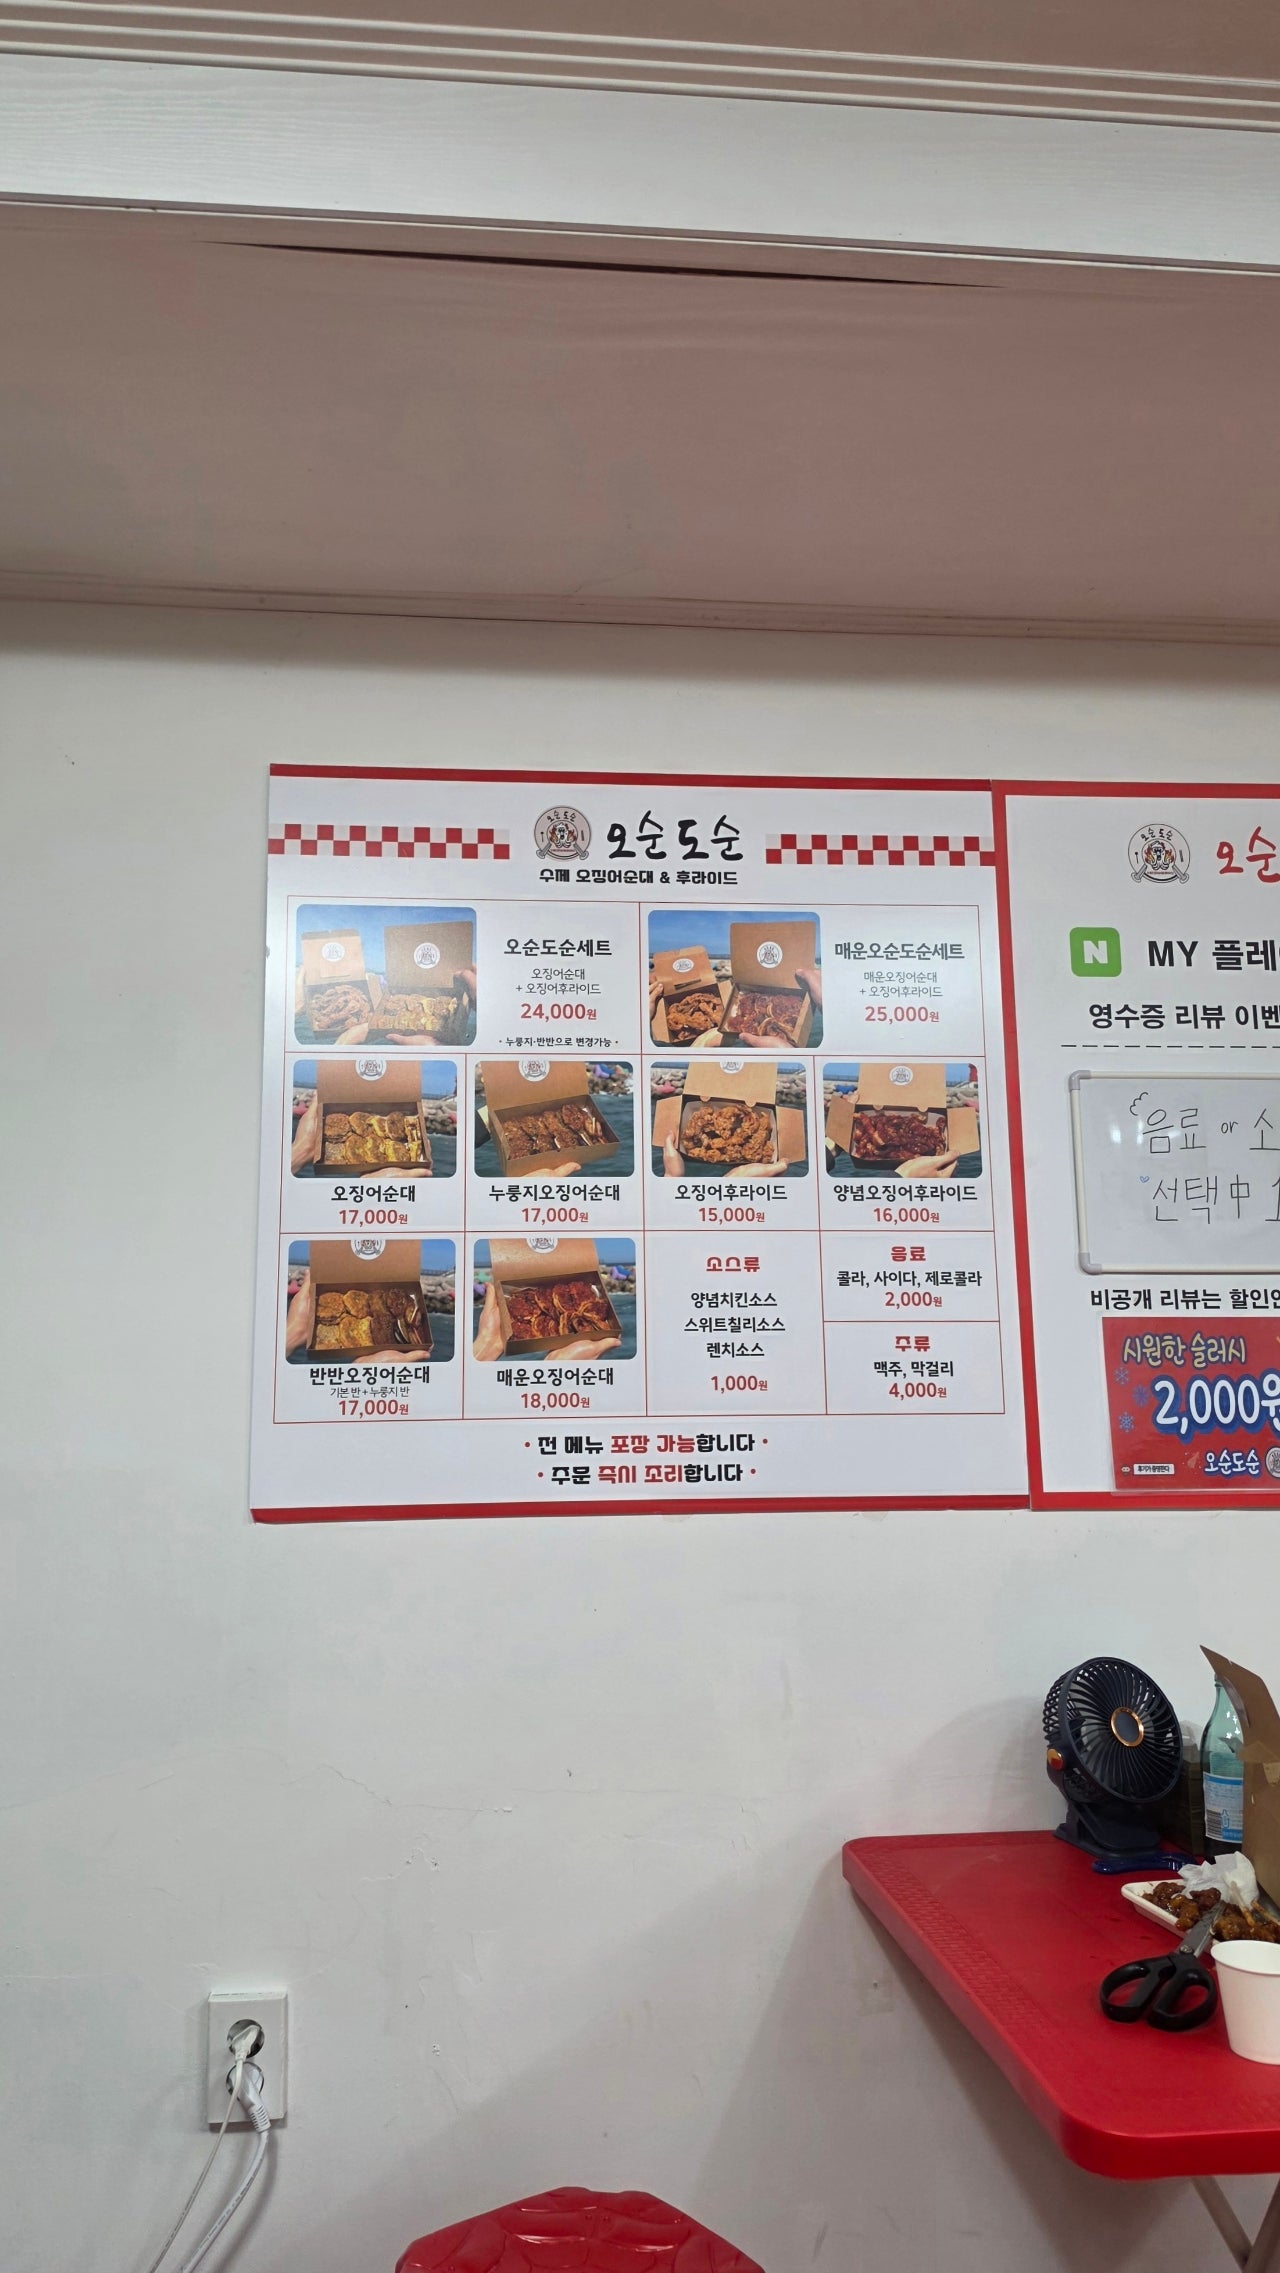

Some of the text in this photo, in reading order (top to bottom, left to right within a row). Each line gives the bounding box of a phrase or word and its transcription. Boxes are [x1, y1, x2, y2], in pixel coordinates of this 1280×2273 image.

[607, 810, 743, 861] 오순도순
[539, 869, 738, 885] 수제 오징어순대 & 후라이드
[504, 939, 612, 957] 오순도순세트
[835, 942, 965, 960] 매운오순도순세트
[1148, 940, 1280, 971] MY 플레
[531, 968, 585, 980] 오징어순대
[864, 971, 937, 983] 매운오징어순대
[525, 983, 601, 995] 오징어후라이드
[869, 986, 943, 998] 오징어후라이드
[521, 1003, 596, 1022] 24,000원
[865, 1006, 939, 1024] 25,000원
[1089, 1004, 1165, 1029] 영수증
[1175, 1004, 1225, 1029] 리뷰
[576, 1037, 612, 1047] 변경가능
[1141, 1107, 1207, 1154] 음료
[1220, 1119, 1240, 1135] or
[331, 1185, 415, 1203] 오징어순대
[489, 1184, 619, 1202] 누룽지오징어순대
[675, 1184, 787, 1201] 오징어후라이드
[834, 1185, 978, 1202] 양념오징어후라이드
[1152, 1173, 1219, 1226] 선택
[339, 1209, 407, 1227] 17,000원
[522, 1208, 588, 1225] 17,000원
[699, 1207, 765, 1225] 15,000원
[874, 1208, 939, 1225] 16,000원
[891, 1246, 926, 1262] 음료
[706, 1257, 760, 1272] 소스류
[837, 1271, 982, 1288] 콜라, 사이다, 제로콜라
[691, 1292, 777, 1308] 양념치킨소스
[885, 1292, 942, 1309] 2,000원
[1091, 1289, 1152, 1310] 비공개
[1160, 1289, 1221, 1309] 리뷰는
[684, 1317, 786, 1333] 스위트칠리소스
[707, 1342, 765, 1358] 렌치소스
[895, 1336, 930, 1352] 주류
[1122, 1331, 1248, 1370] 시원한 슬러시
[310, 1366, 429, 1385] 반반오징어순대
[497, 1368, 613, 1386] 매운오징어순대
[874, 1361, 953, 1379] 맥주, 막걸리
[329, 1385, 350, 1399] 기본
[350, 1385, 360, 1398] 반
[369, 1386, 398, 1398] 누룽지
[399, 1385, 411, 1398] 반
[711, 1375, 768, 1394] 1,000원
[889, 1382, 946, 1400] 4,000원
[339, 1399, 408, 1419] 17,000원
[521, 1393, 590, 1411] 18,000원
[538, 1434, 755, 1455] 전 메뉴 포장 가능합니다
[1203, 1449, 1261, 1475] 오순도순
[551, 1464, 743, 1485] 주문 즉시 조리합니다
